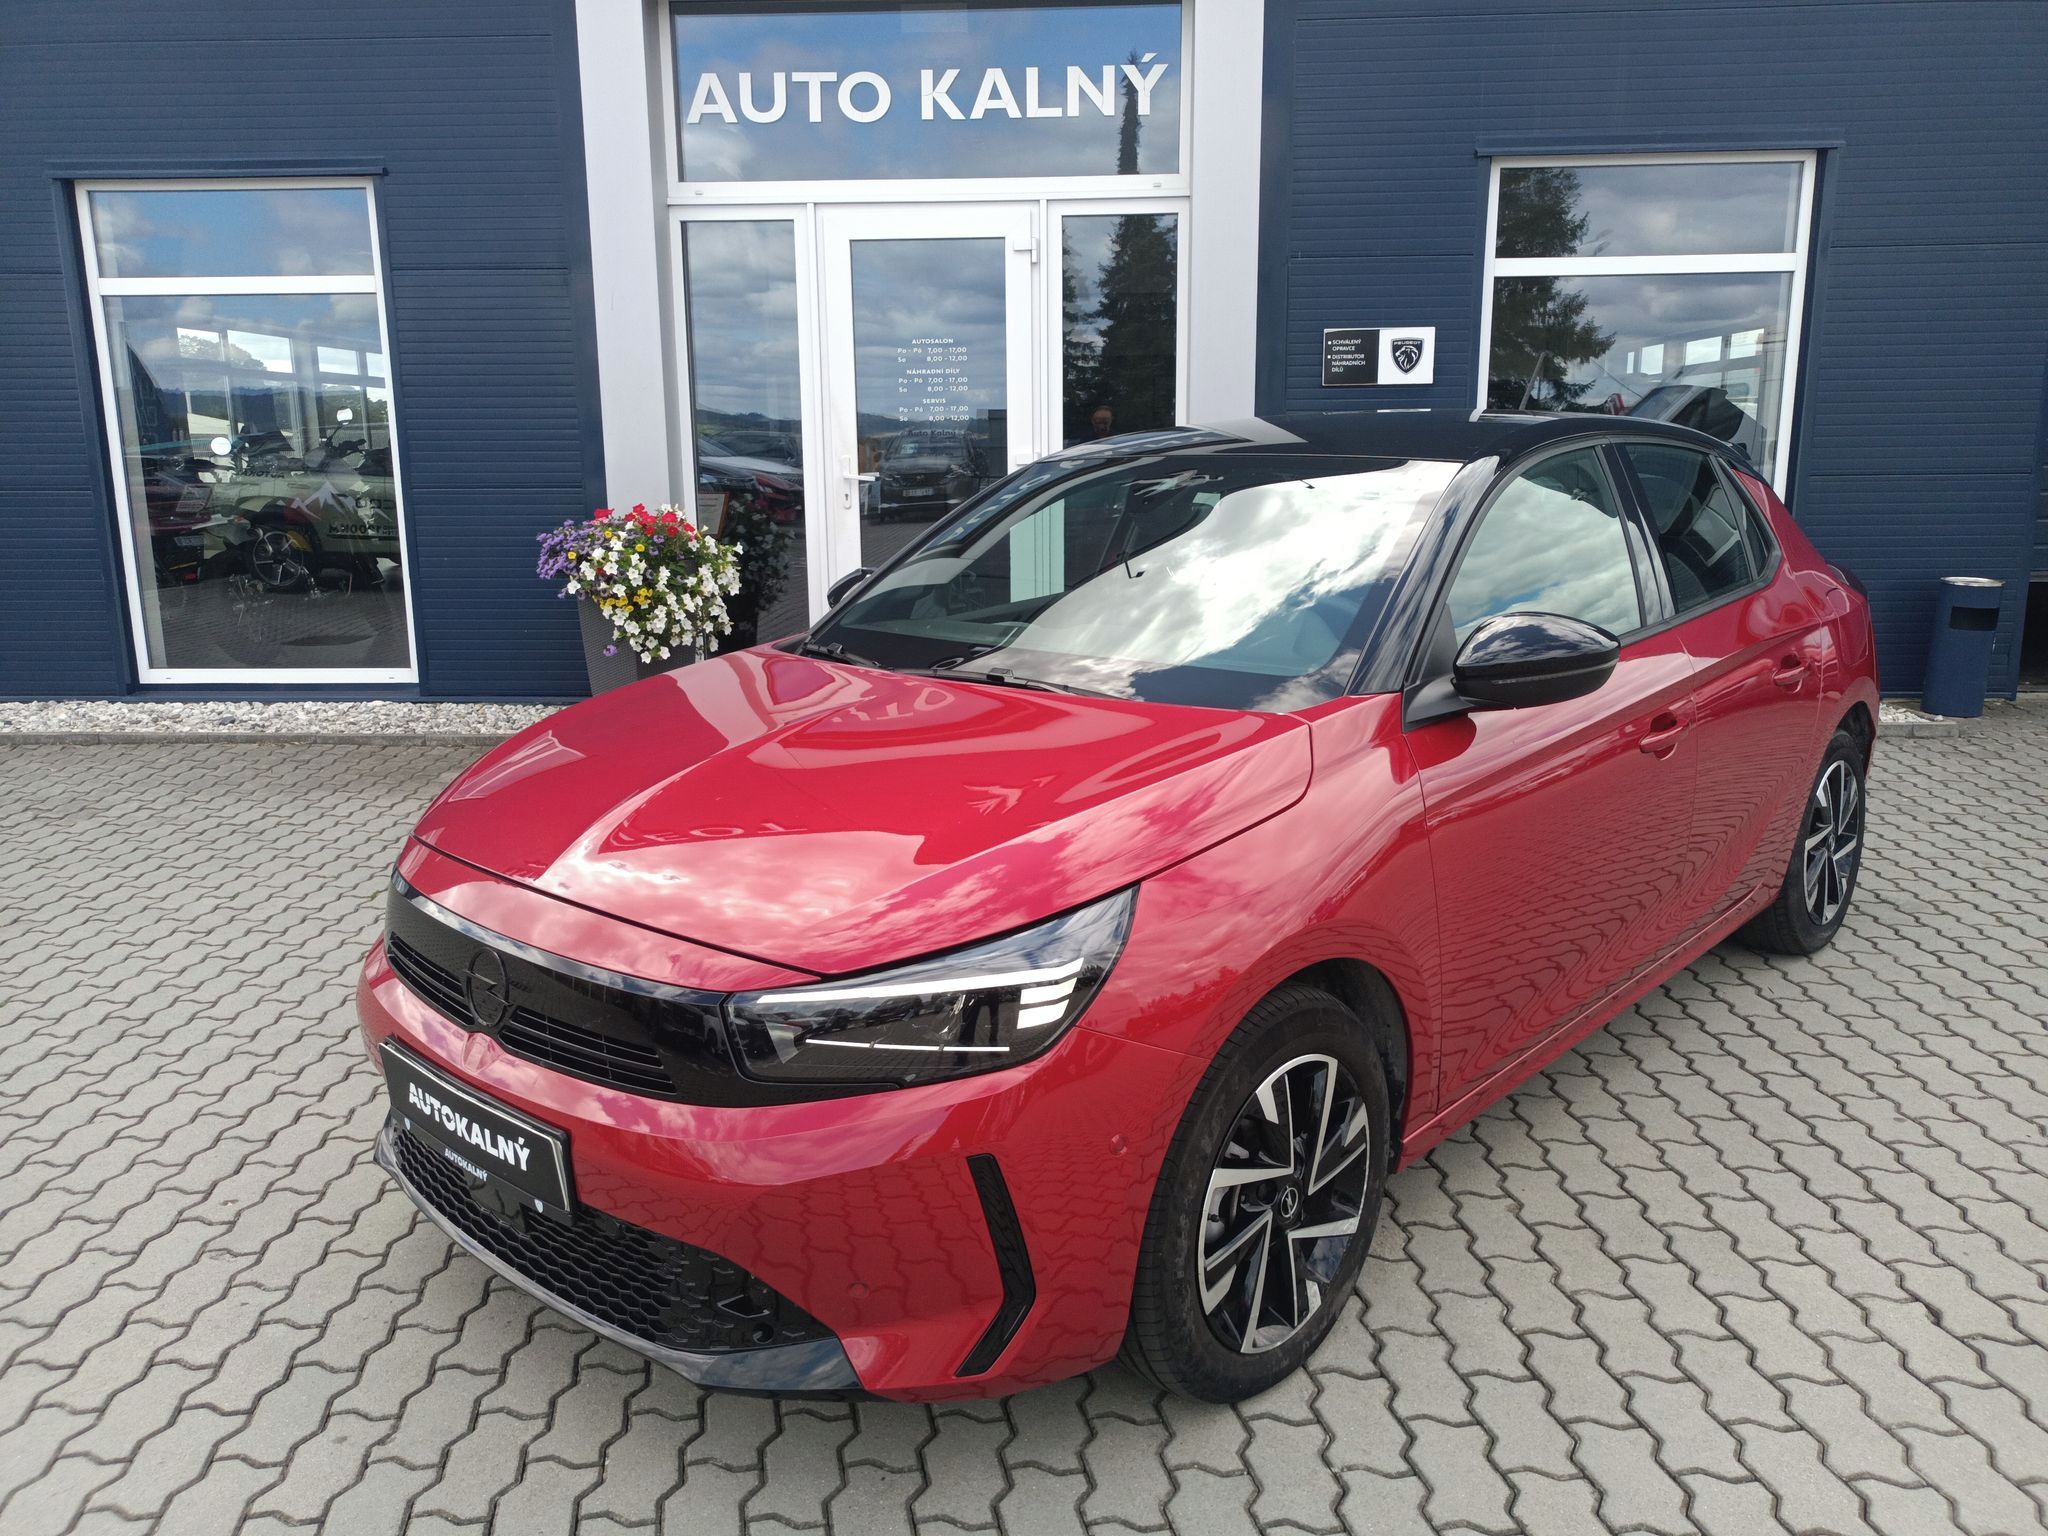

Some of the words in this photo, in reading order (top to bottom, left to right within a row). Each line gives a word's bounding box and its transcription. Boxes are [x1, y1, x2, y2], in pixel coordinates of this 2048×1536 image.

[686, 71, 892, 124] AUTO
[920, 52, 1169, 121] KALNÝ
[409, 1081, 530, 1172] AUTOKALNÝ
[444, 1148, 488, 1182] AUTOKALNÝ
